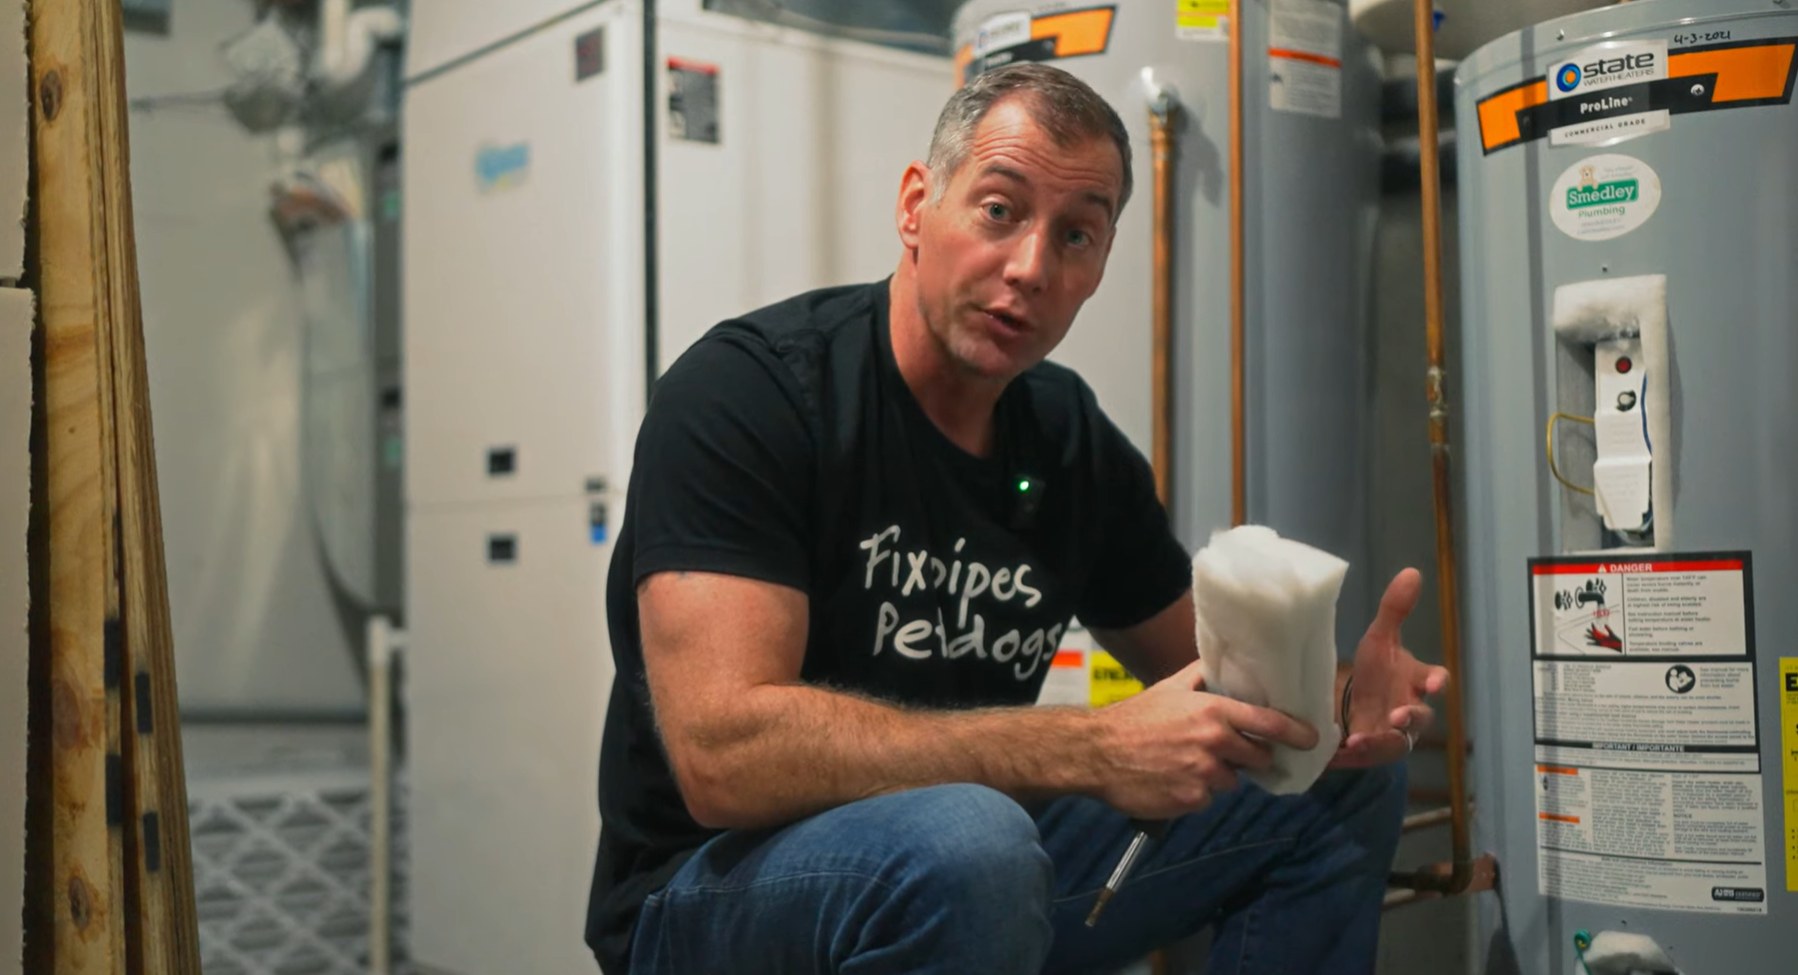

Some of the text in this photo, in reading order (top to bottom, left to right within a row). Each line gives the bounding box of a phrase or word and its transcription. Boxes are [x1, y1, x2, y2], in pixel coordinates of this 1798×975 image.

[1673, 30, 1731, 44] 4-3-2021
[1583, 52, 1655, 78] state
[1584, 69, 1655, 87] WATER HEATERS
[1580, 97, 1629, 114] ProLine
[1564, 118, 1646, 138] COMMERCIAL GRADE
[1568, 184, 1635, 205] Smedley
[1578, 205, 1626, 218] Plumbing
[859, 524, 928, 597] Fix
[1609, 563, 1653, 573] DANGER
